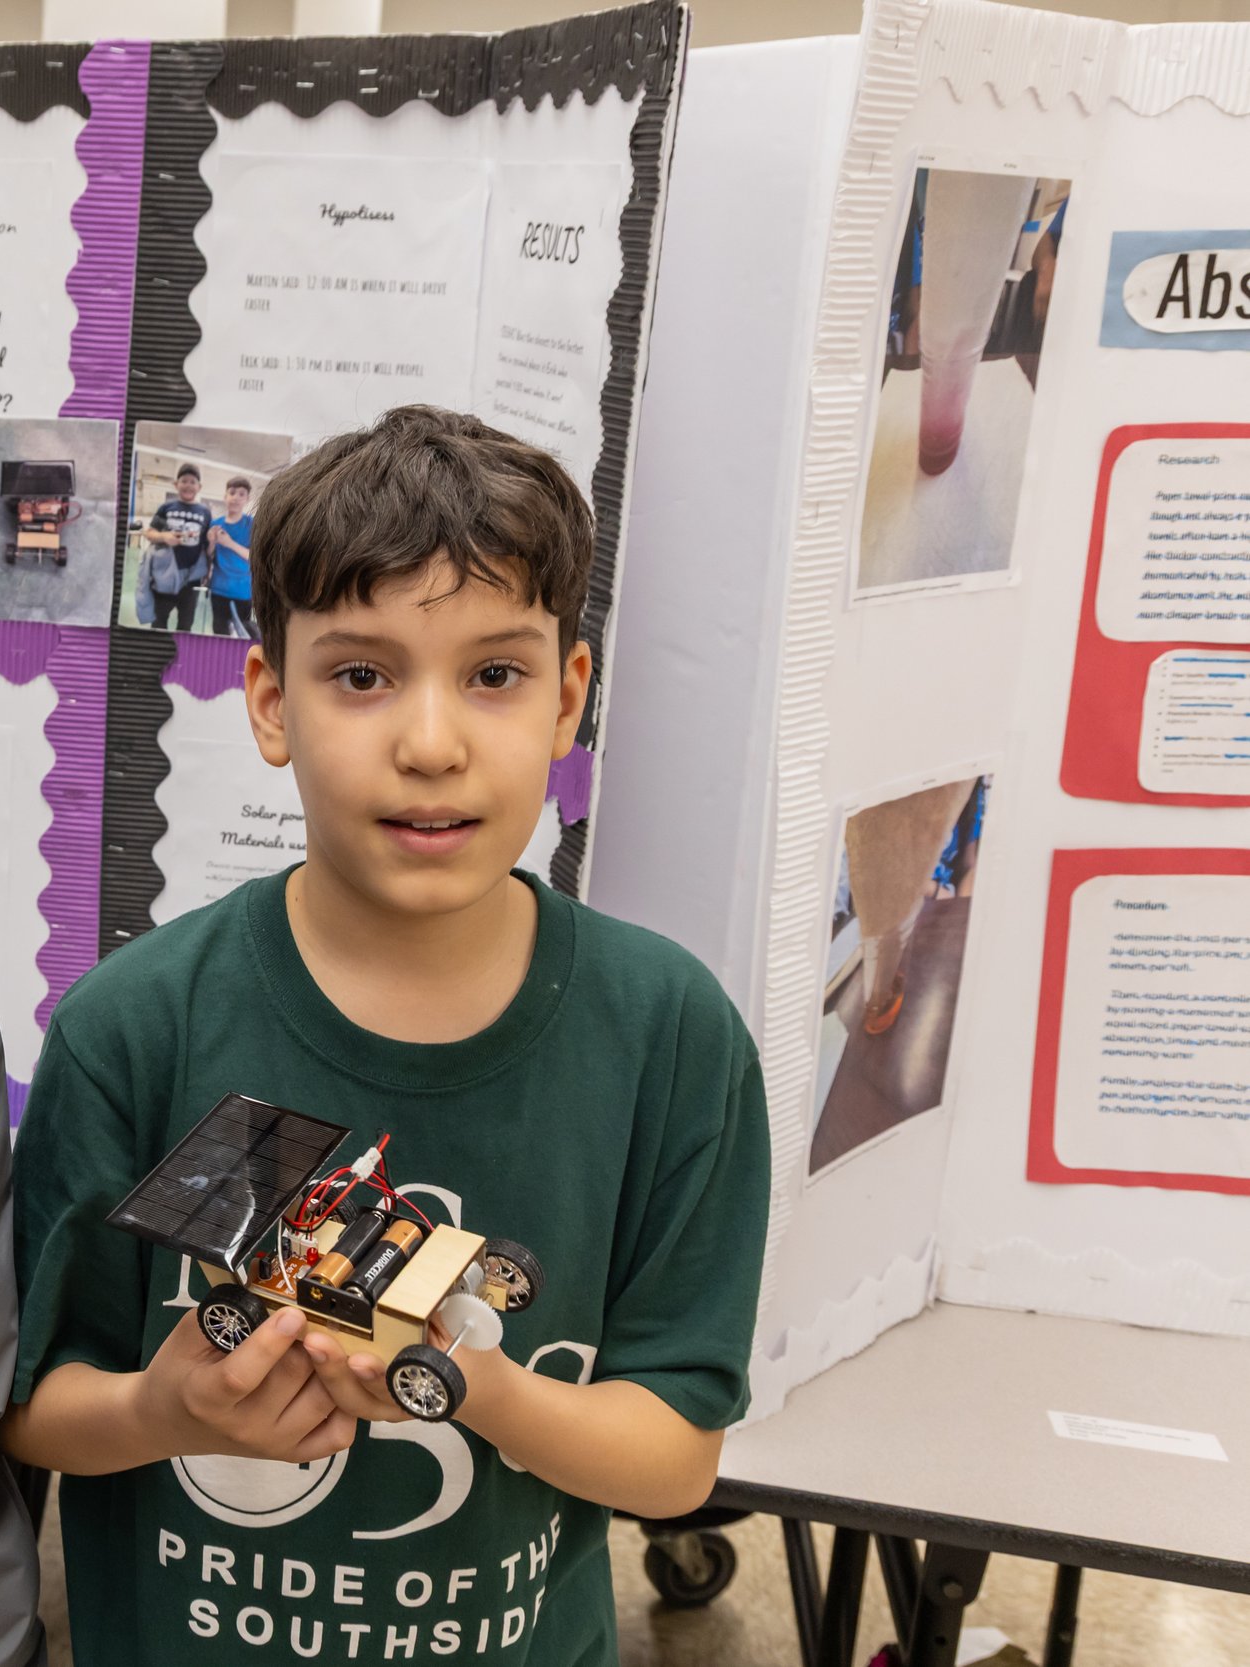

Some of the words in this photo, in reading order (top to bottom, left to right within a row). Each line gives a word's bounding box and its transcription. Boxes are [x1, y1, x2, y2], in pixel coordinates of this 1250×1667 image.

[519, 222, 585, 264] RESULTS
[1155, 253, 1250, 319] Abs
[241, 804, 277, 819] Solar
[220, 831, 285, 850] Materials
[365, 1248, 395, 1281] DURACELL
[159, 1528, 365, 1605] PRIDE
[395, 1567, 477, 1608] OF
